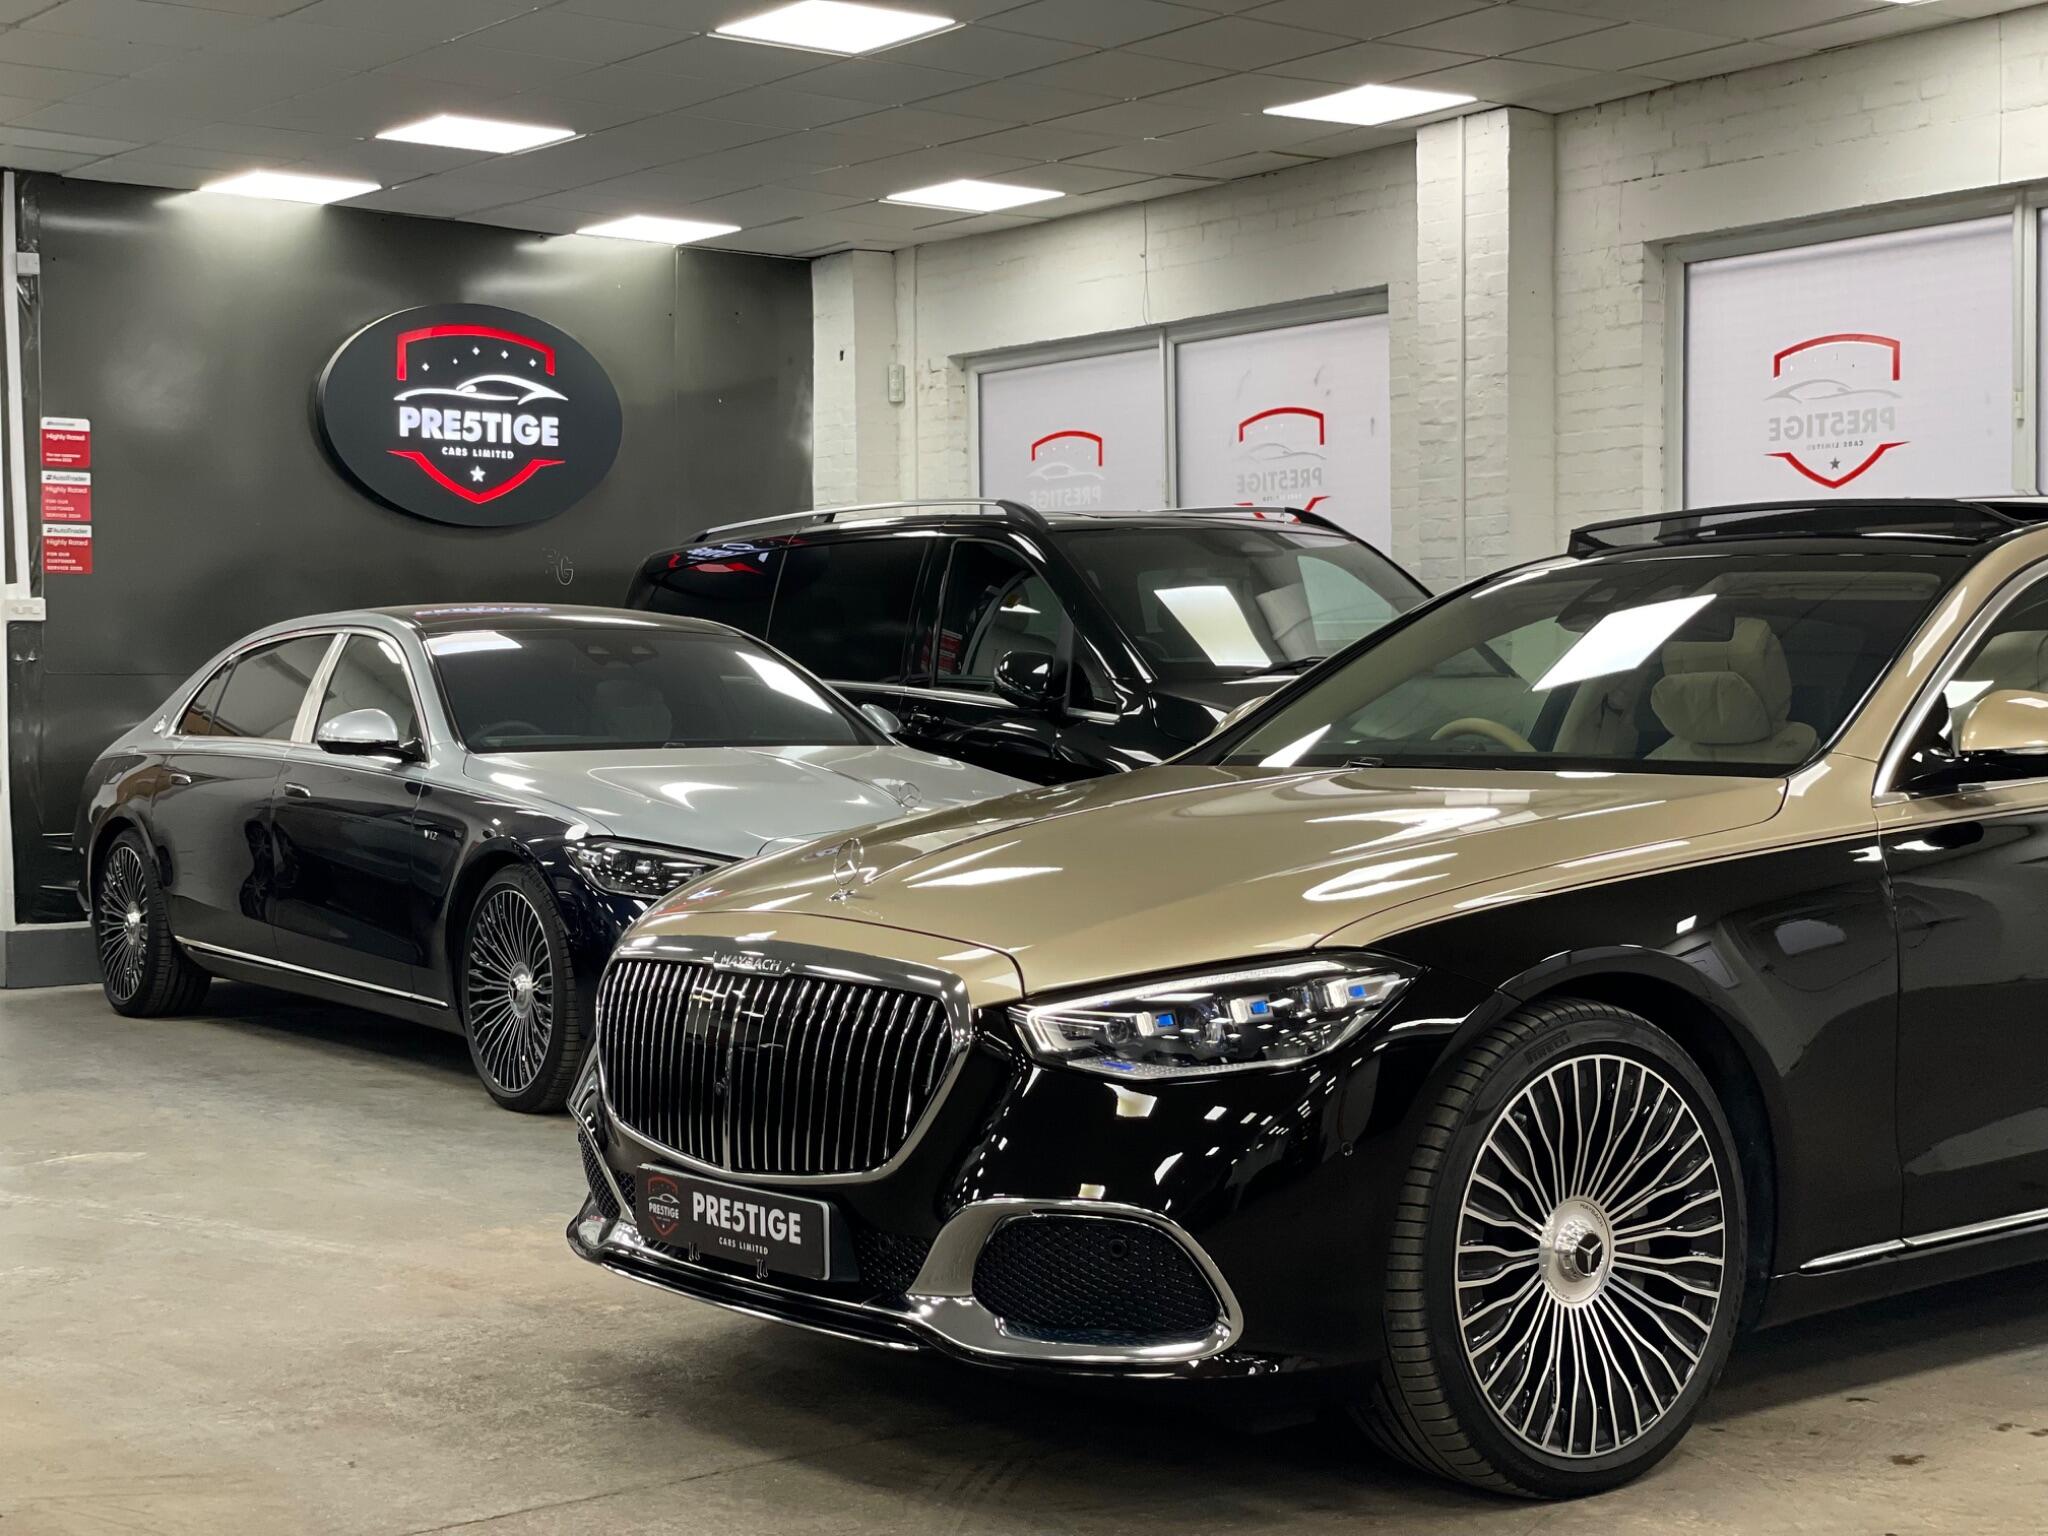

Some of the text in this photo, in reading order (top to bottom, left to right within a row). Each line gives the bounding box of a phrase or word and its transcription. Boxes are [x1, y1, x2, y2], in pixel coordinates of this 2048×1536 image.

[441, 447, 514, 460] CARS LIMITED
[720, 955, 782, 972] MAYBACH
[718, 1236, 769, 1256] CARS LIMITED
